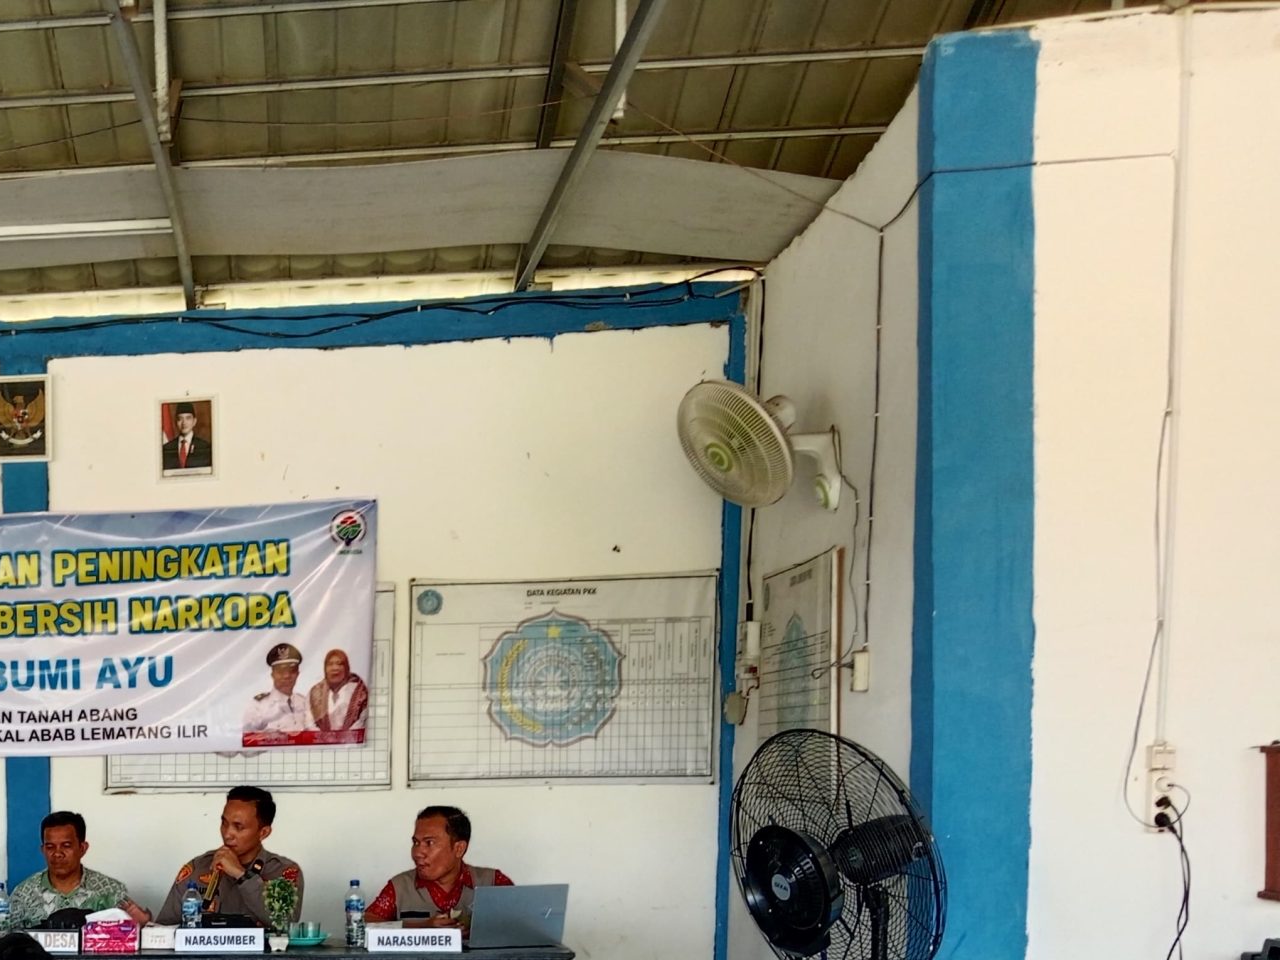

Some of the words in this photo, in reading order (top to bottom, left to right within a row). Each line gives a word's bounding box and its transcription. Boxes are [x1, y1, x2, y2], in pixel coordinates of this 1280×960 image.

[52, 539, 291, 586] PENINGKATAN
[129, 591, 297, 634] NARKOBA
[96, 655, 173, 689] AYU
[17, 710, 73, 724] TANAH
[78, 708, 138, 722] ABANG
[28, 728, 75, 742] ABAB
[81, 726, 171, 741] LEMATANG
[177, 725, 208, 738] ILIR
[44, 933, 77, 949] DESA
[185, 935, 256, 946] NARASUMBER
[377, 935, 452, 946] NARASUMBER
